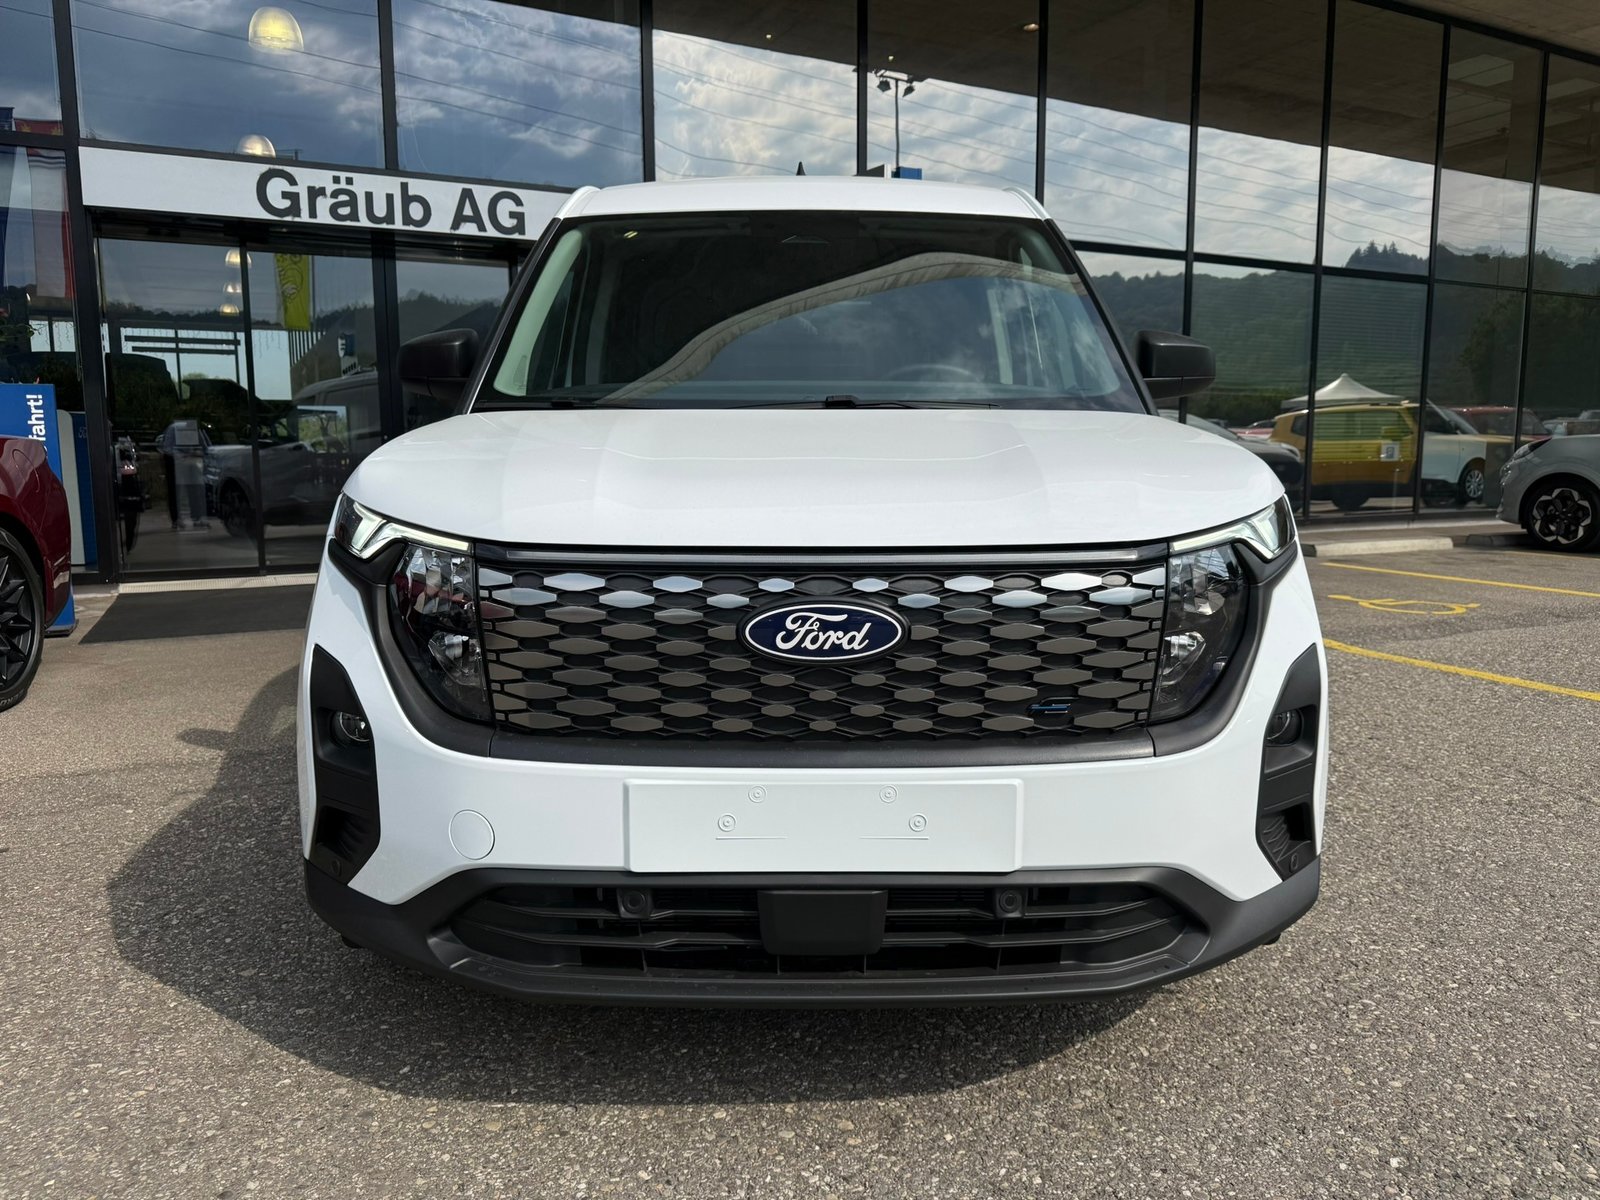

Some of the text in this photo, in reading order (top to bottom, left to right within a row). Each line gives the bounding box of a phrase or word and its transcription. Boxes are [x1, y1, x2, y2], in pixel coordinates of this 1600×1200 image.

[256, 168, 526, 236] Gräub AG
[26, 394, 46, 447] fahrt!
[775, 612, 872, 650] Ford
